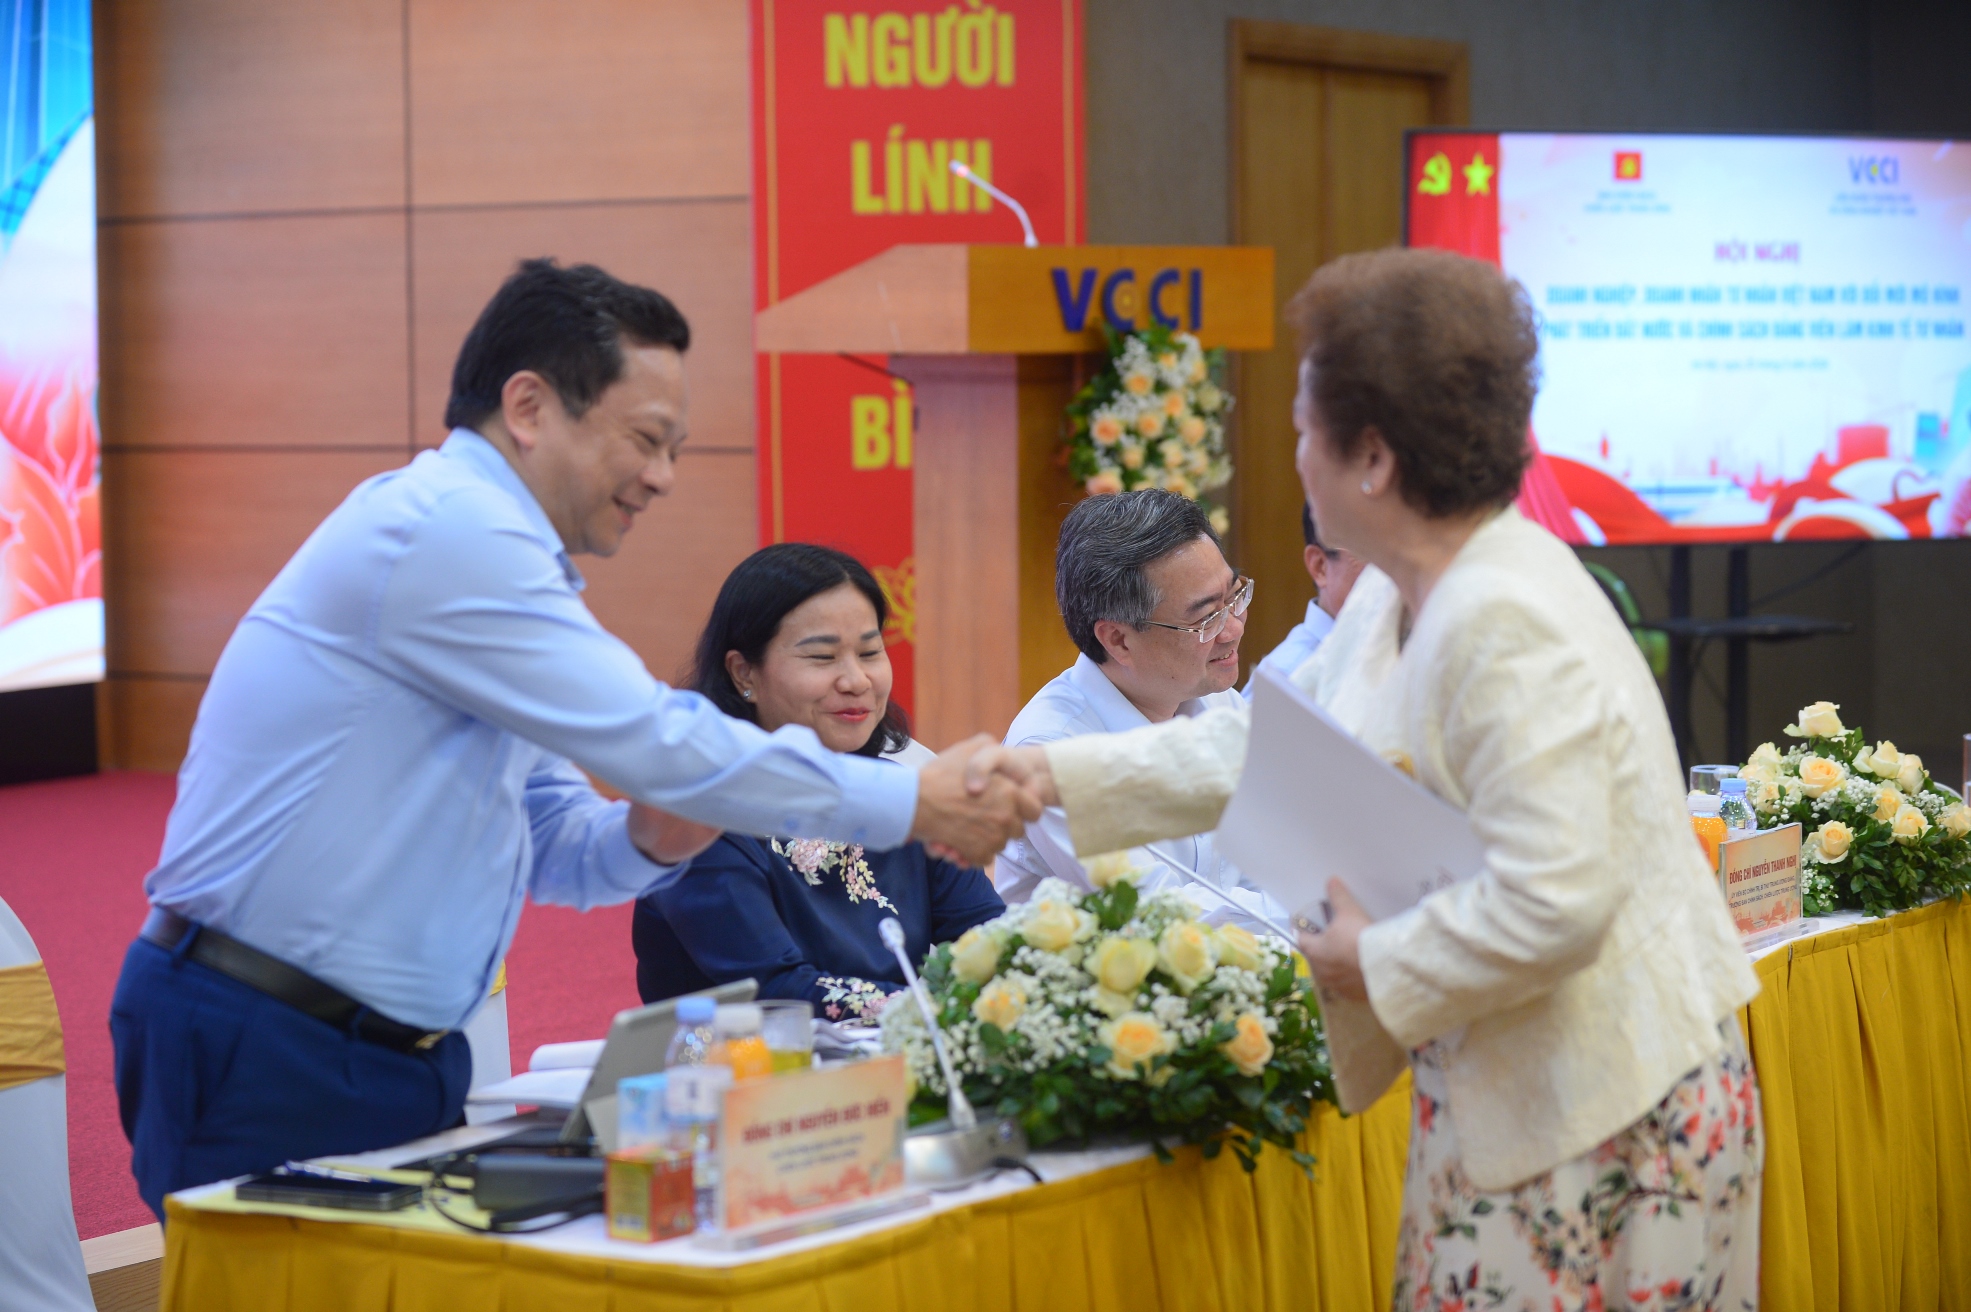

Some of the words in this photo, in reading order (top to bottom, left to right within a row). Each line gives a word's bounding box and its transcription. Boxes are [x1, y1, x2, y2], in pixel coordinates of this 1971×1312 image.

[825, 0, 1015, 88] NGƯỜI
[852, 124, 992, 214] LÍNH
[1848, 156, 1899, 185] VCCI
[1051, 268, 1203, 332] VCCI
[852, 378, 912, 469] BÌ
[1771, 858, 1786, 873] THANH
